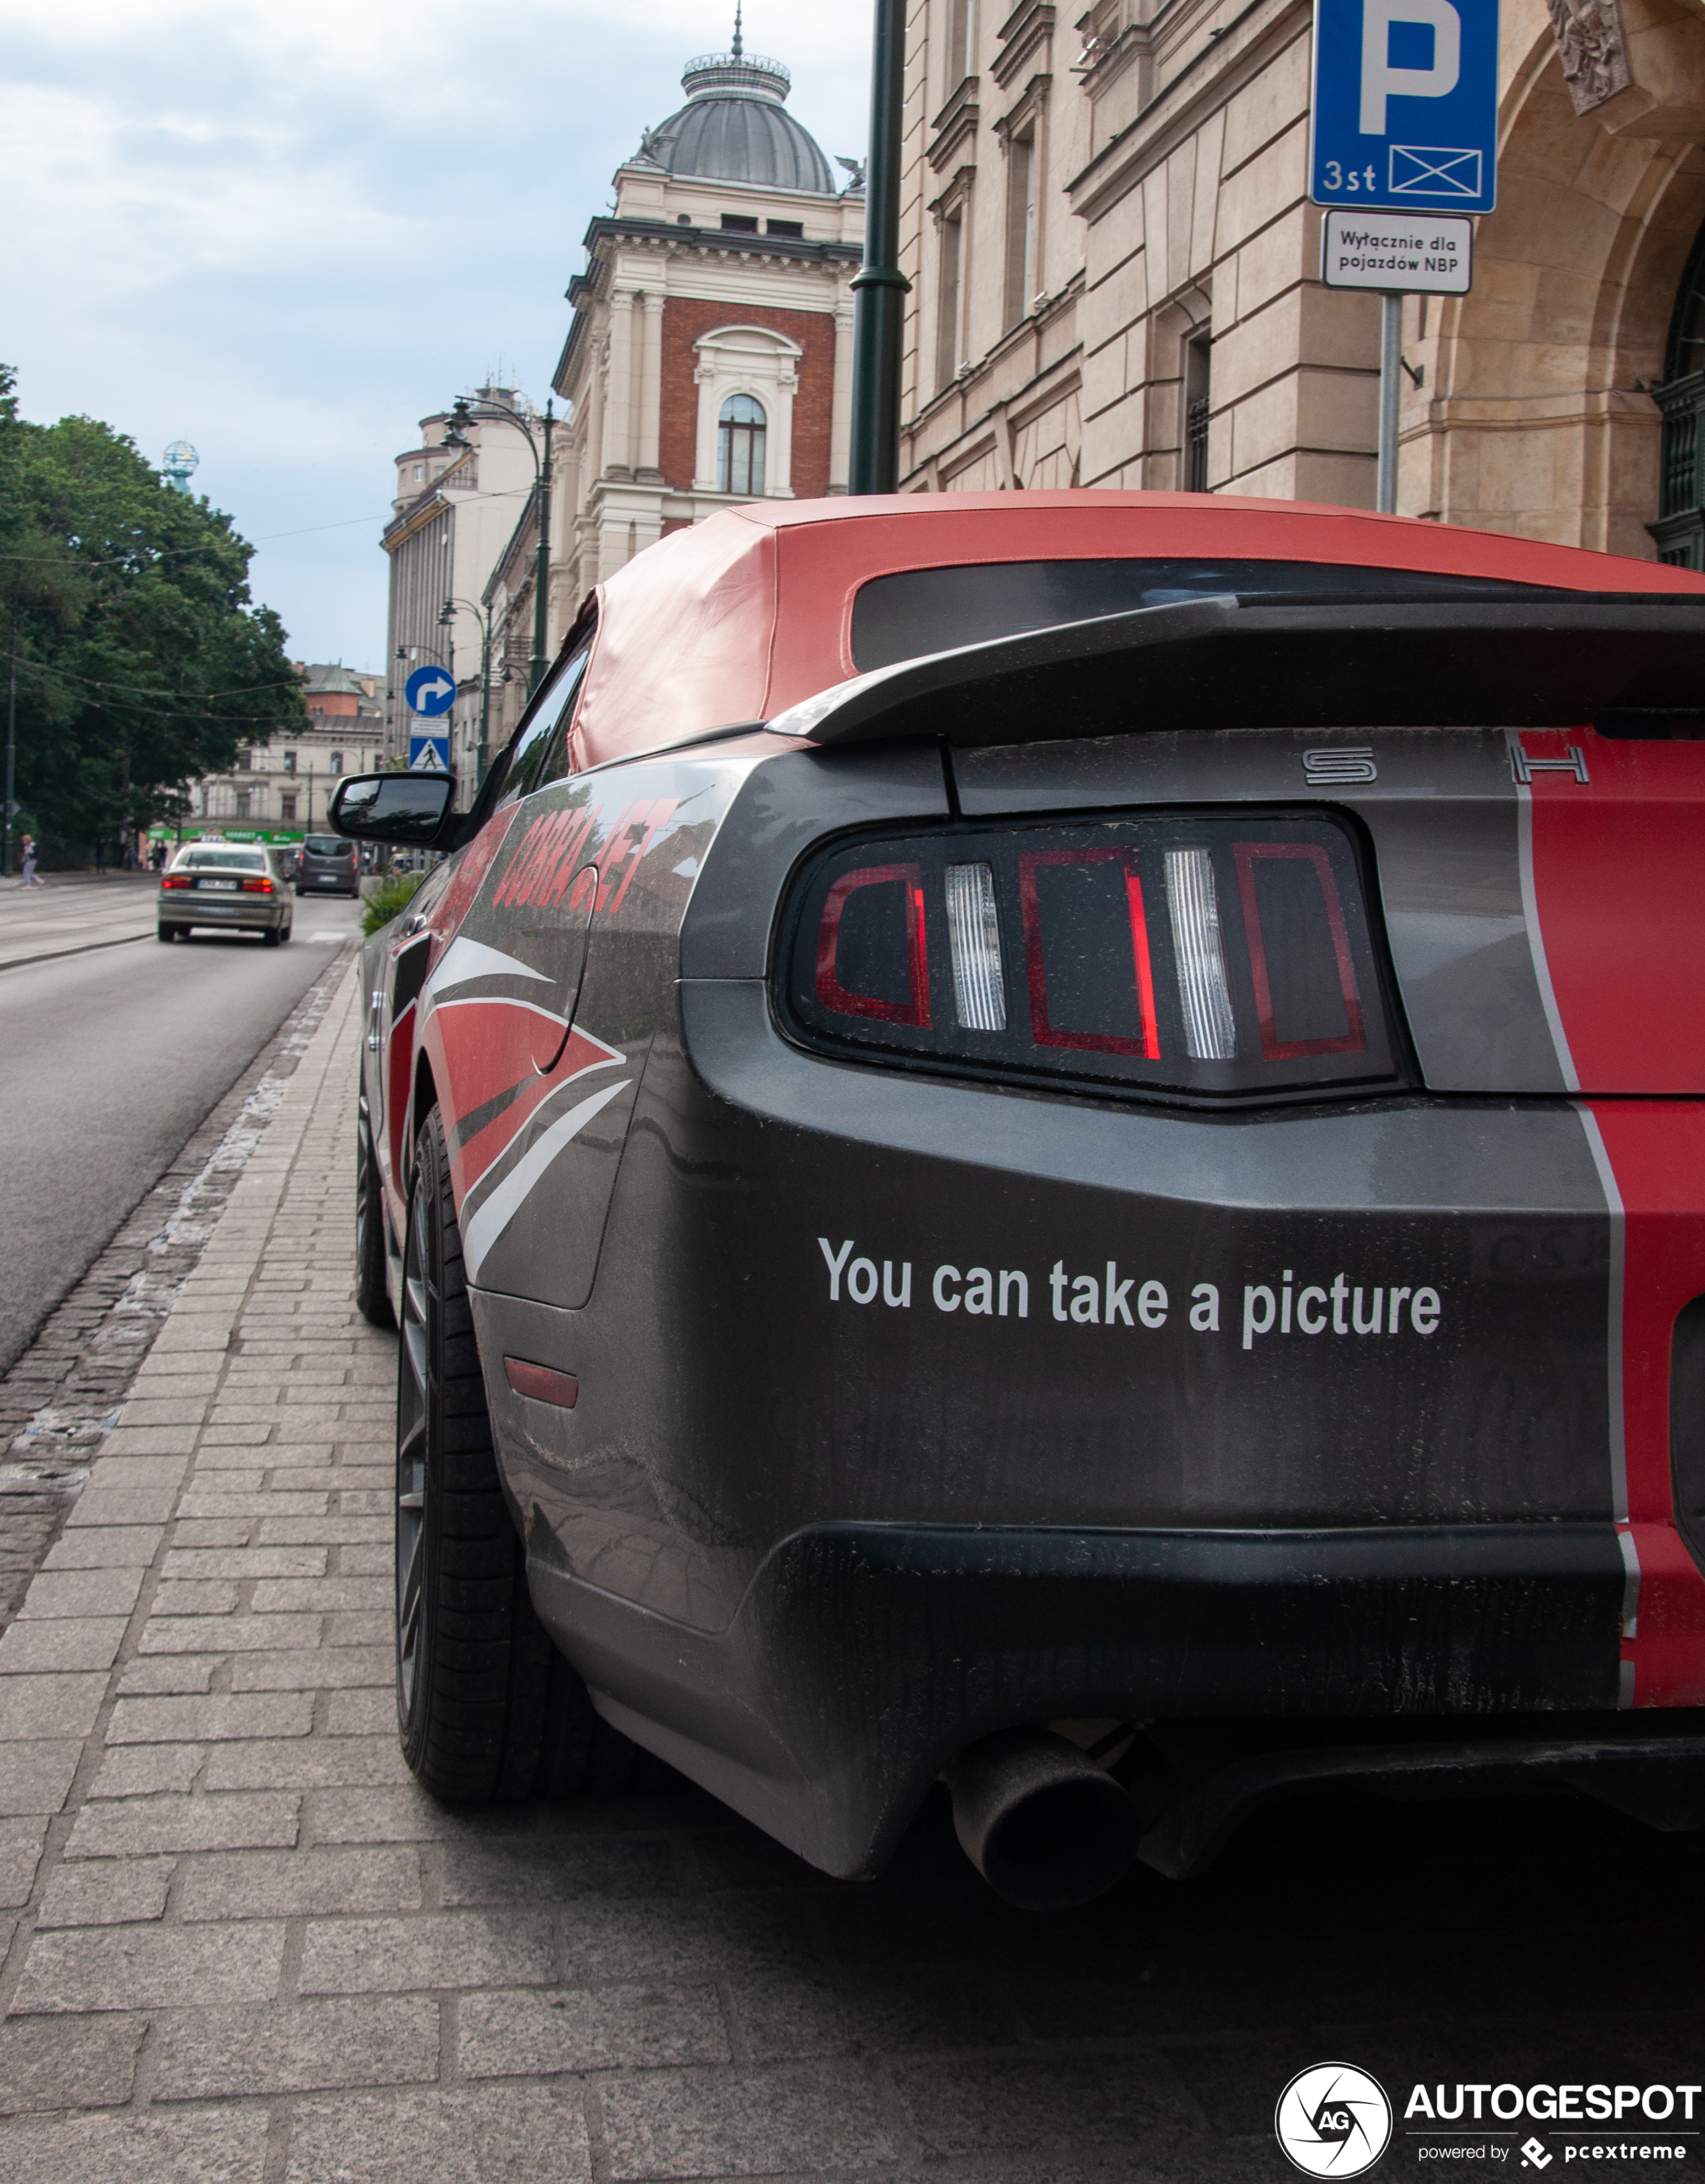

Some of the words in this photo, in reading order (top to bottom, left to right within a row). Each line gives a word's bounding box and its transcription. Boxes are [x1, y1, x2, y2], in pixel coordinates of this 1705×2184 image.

[1359, 0, 1461, 136] P
[1322, 160, 1376, 191] 3st
[1340, 254, 1418, 271] pojazdów
[1424, 258, 1458, 273] NBP
[1341, 231, 1424, 251] Wyłącznie
[1430, 236, 1456, 251] dla
[492, 804, 603, 907] COBRA
[570, 798, 681, 914] JET
[818, 1237, 912, 1308] You
[932, 1264, 1029, 1318] can
[1049, 1259, 1169, 1329] take
[1189, 1283, 1220, 1332] a
[1243, 1269, 1442, 1350] picture
